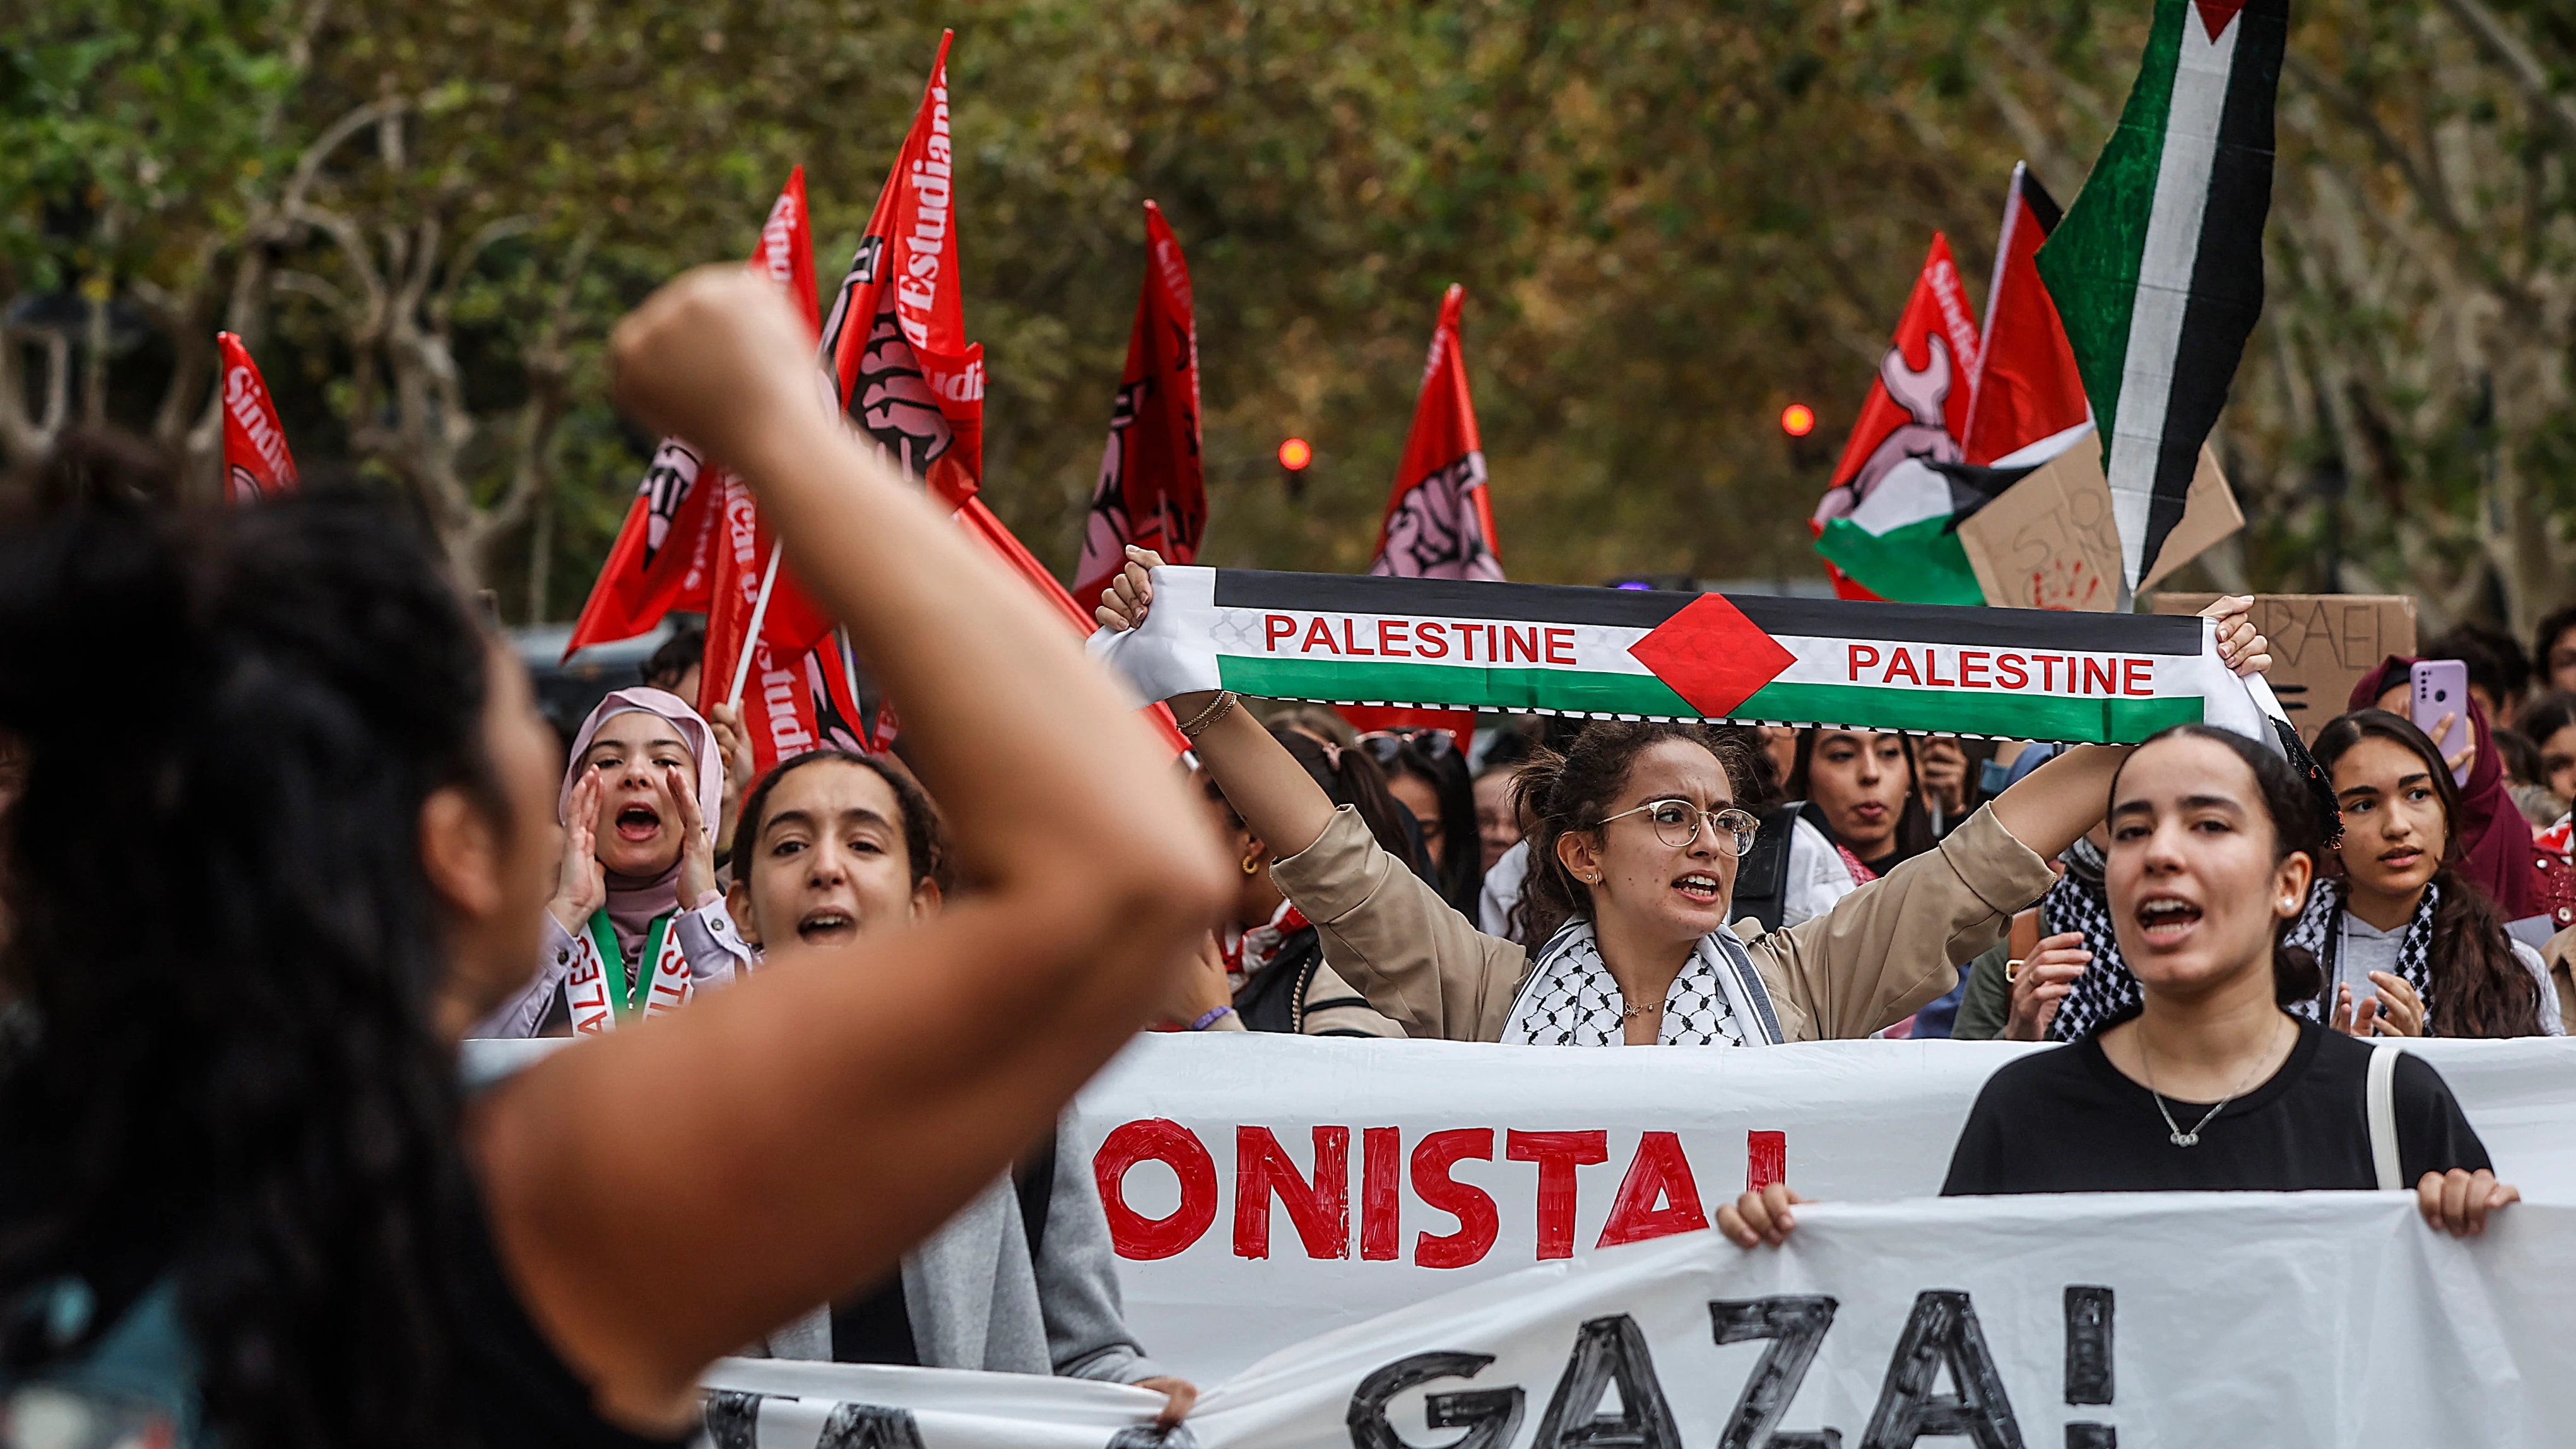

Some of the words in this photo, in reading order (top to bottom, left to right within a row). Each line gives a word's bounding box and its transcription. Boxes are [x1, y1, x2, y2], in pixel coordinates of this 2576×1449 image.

[1265, 615, 1576, 665] PALESTINE
[1848, 645, 2154, 695] PALESTINE
[1347, 1285, 2118, 1449] GAZA!
